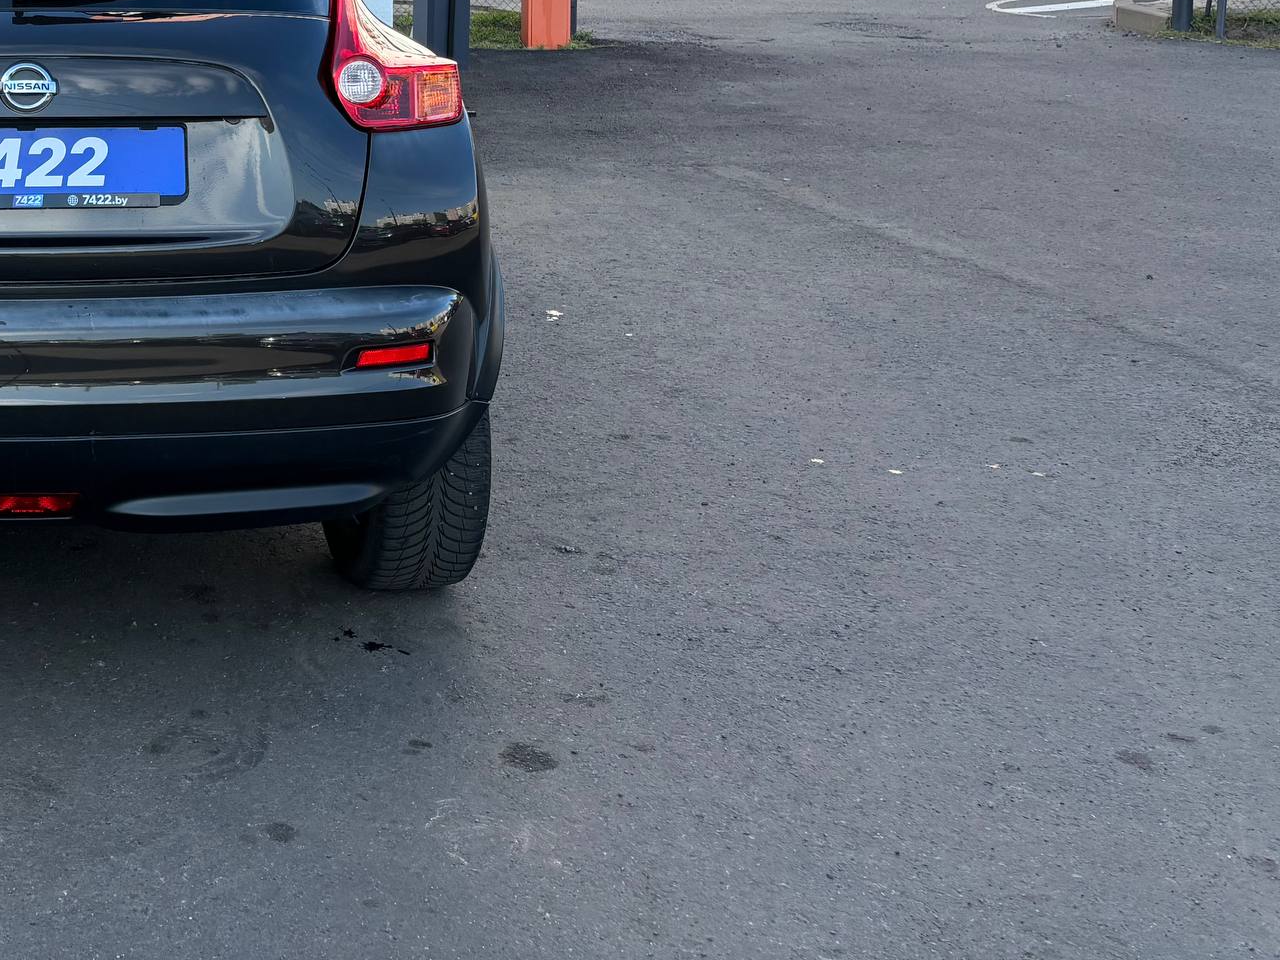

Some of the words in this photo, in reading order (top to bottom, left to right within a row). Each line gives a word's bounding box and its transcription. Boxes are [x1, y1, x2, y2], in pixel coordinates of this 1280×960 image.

[3, 82, 50, 91] NISSAN
[15, 195, 41, 205] 7422
[82, 194, 129, 207] 7422.by
